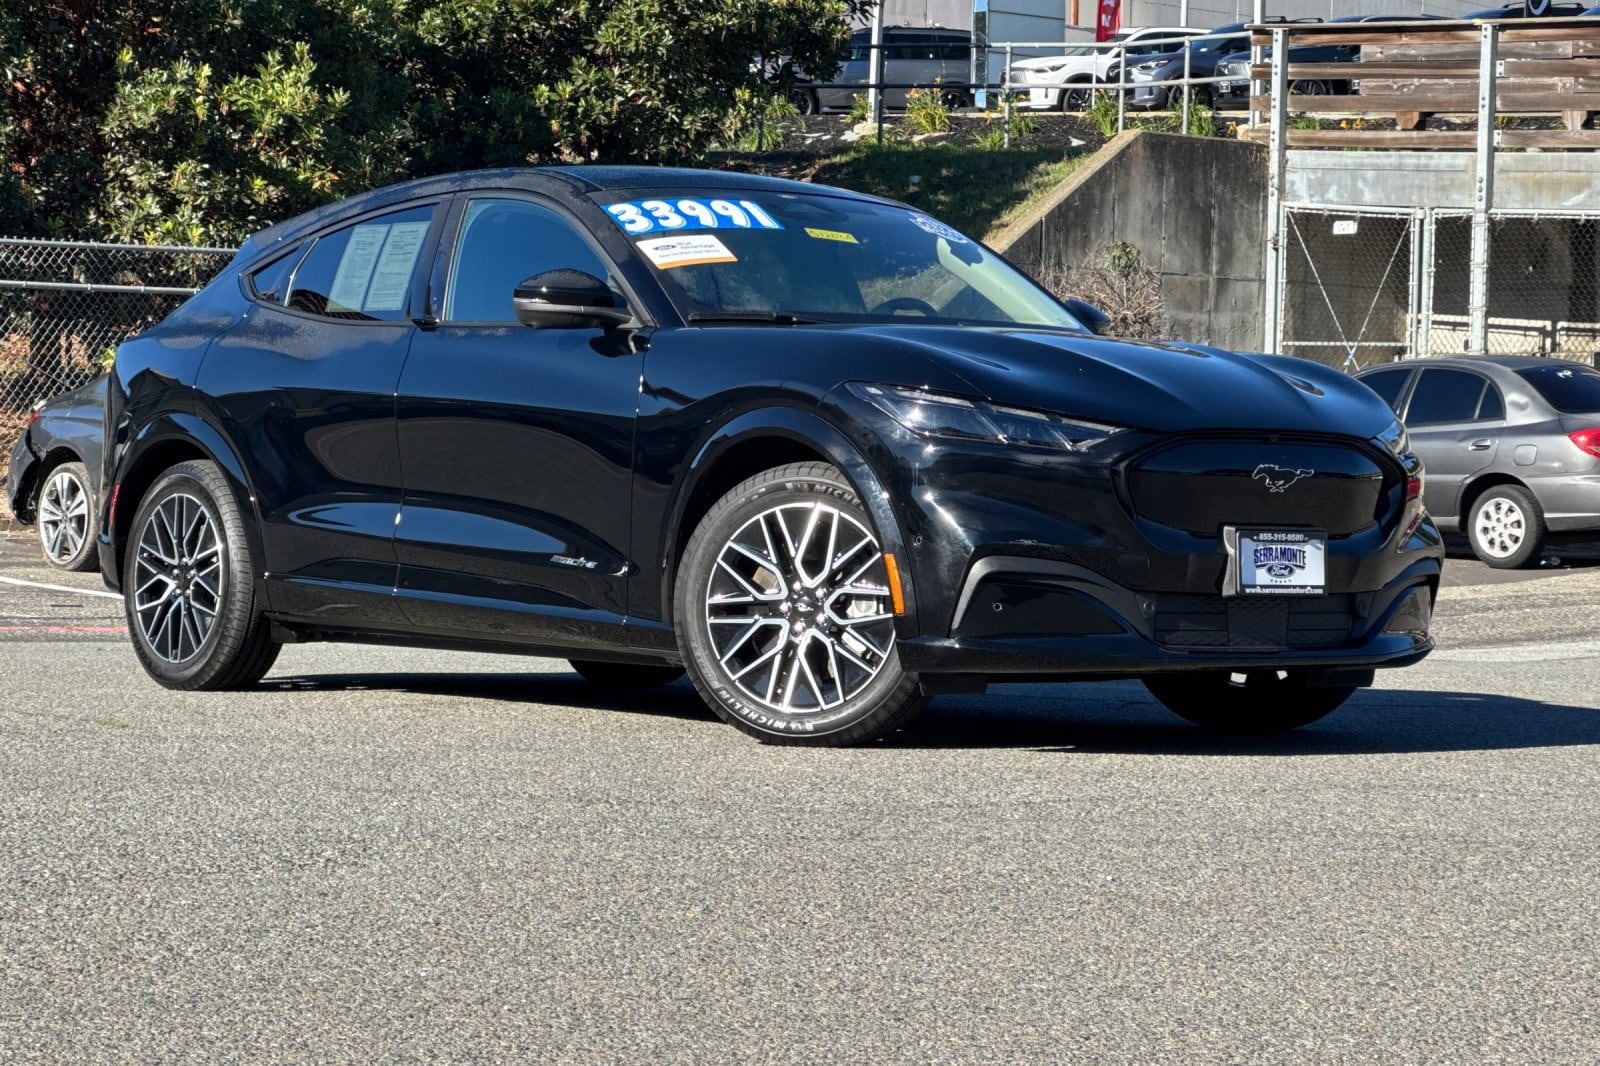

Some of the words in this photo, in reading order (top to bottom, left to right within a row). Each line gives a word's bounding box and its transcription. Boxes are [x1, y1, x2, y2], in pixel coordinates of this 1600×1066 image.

[607, 199, 781, 233] 33991
[1254, 546, 1306, 565] SERRAMONTE
[717, 689, 788, 730] MICHELIN
